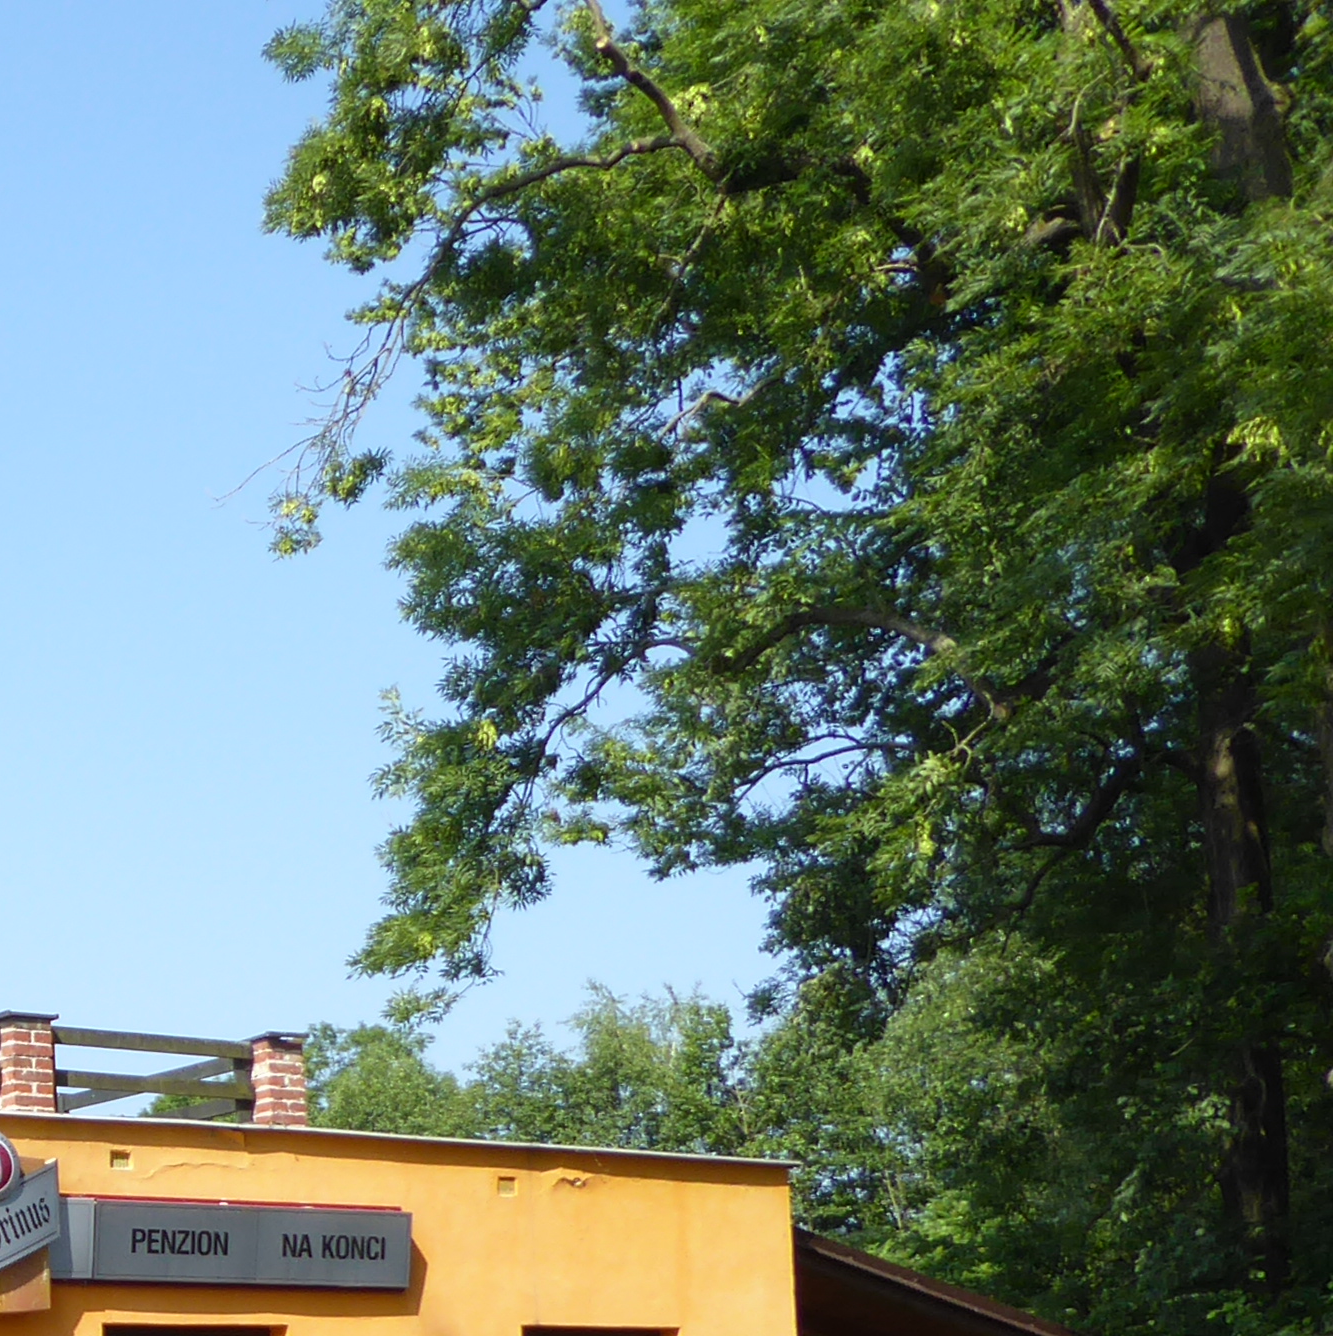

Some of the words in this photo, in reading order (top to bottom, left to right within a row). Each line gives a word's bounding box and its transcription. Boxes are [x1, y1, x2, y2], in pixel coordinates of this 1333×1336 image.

[130, 1227, 229, 1257] PENZION
[281, 1232, 313, 1259] NA
[321, 1234, 386, 1261] KONCI
